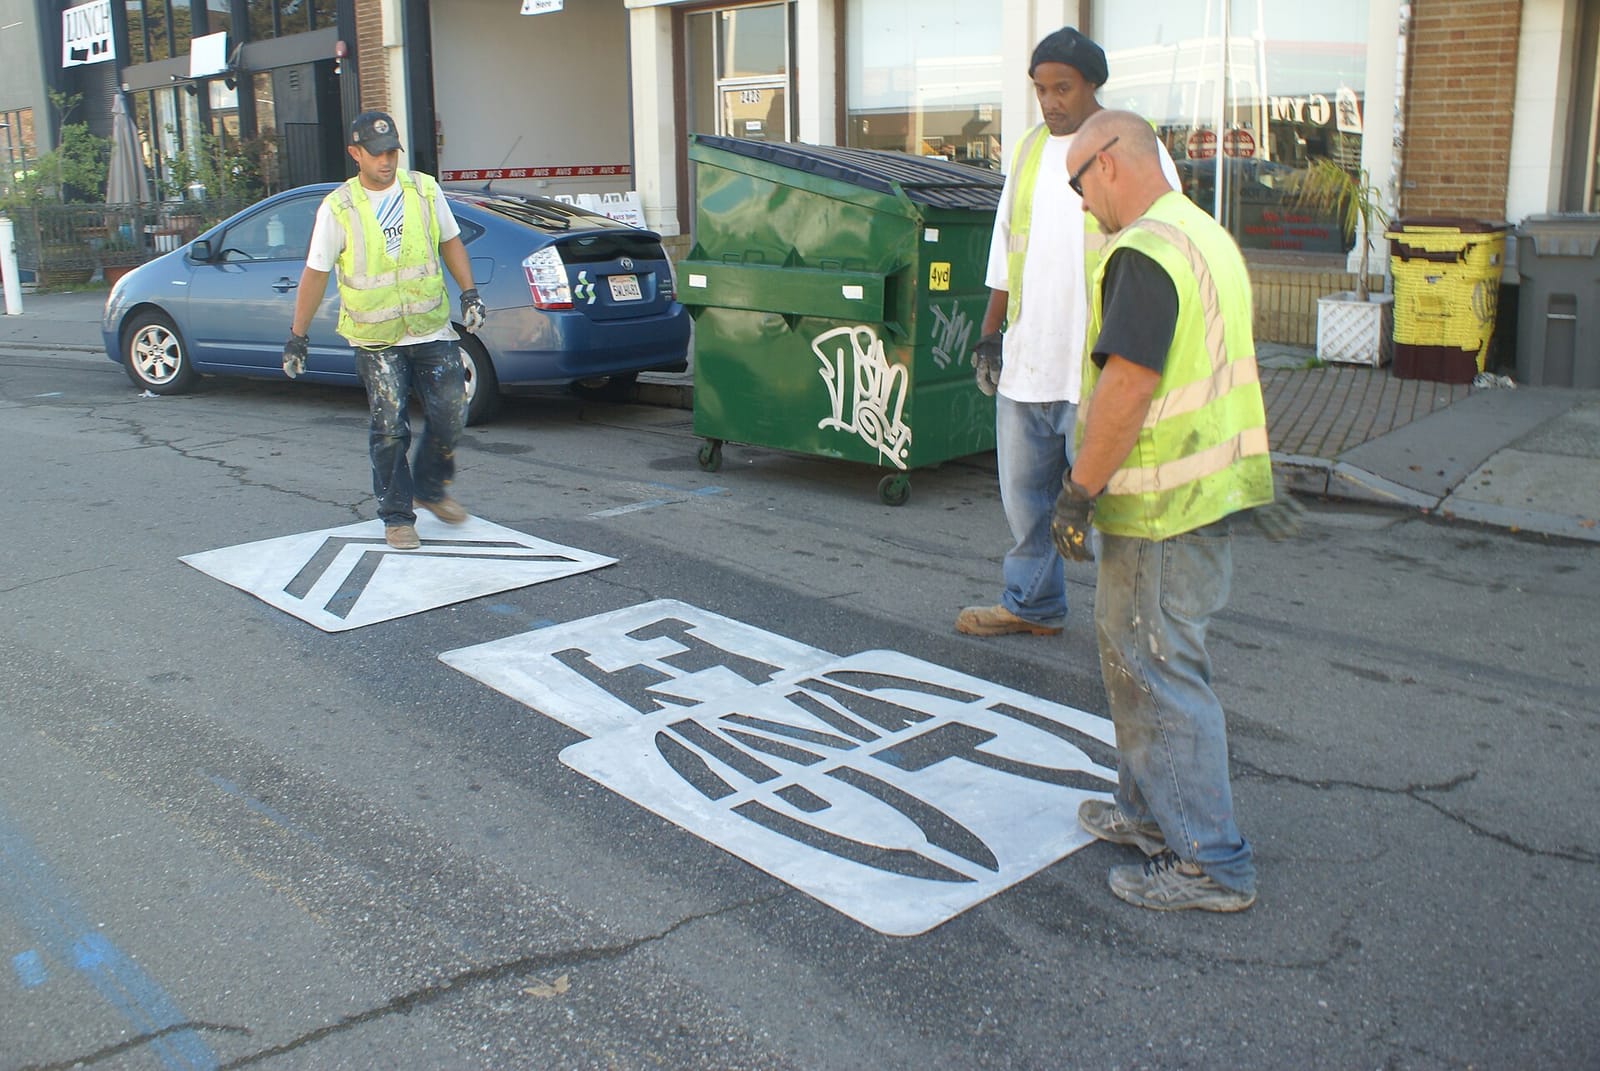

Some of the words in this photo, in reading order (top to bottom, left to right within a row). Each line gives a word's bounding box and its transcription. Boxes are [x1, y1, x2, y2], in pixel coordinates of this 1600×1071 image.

[66, 2, 110, 42] LUNCH
[460, 171, 479, 179] AVIS
[485, 170, 503, 178] AVIS
[509, 169, 527, 177] AVIS
[532, 168, 549, 176] AVIS
[577, 167, 593, 175] AVIS
[599, 166, 615, 174] AVIS
[931, 267, 949, 286] 4yd
